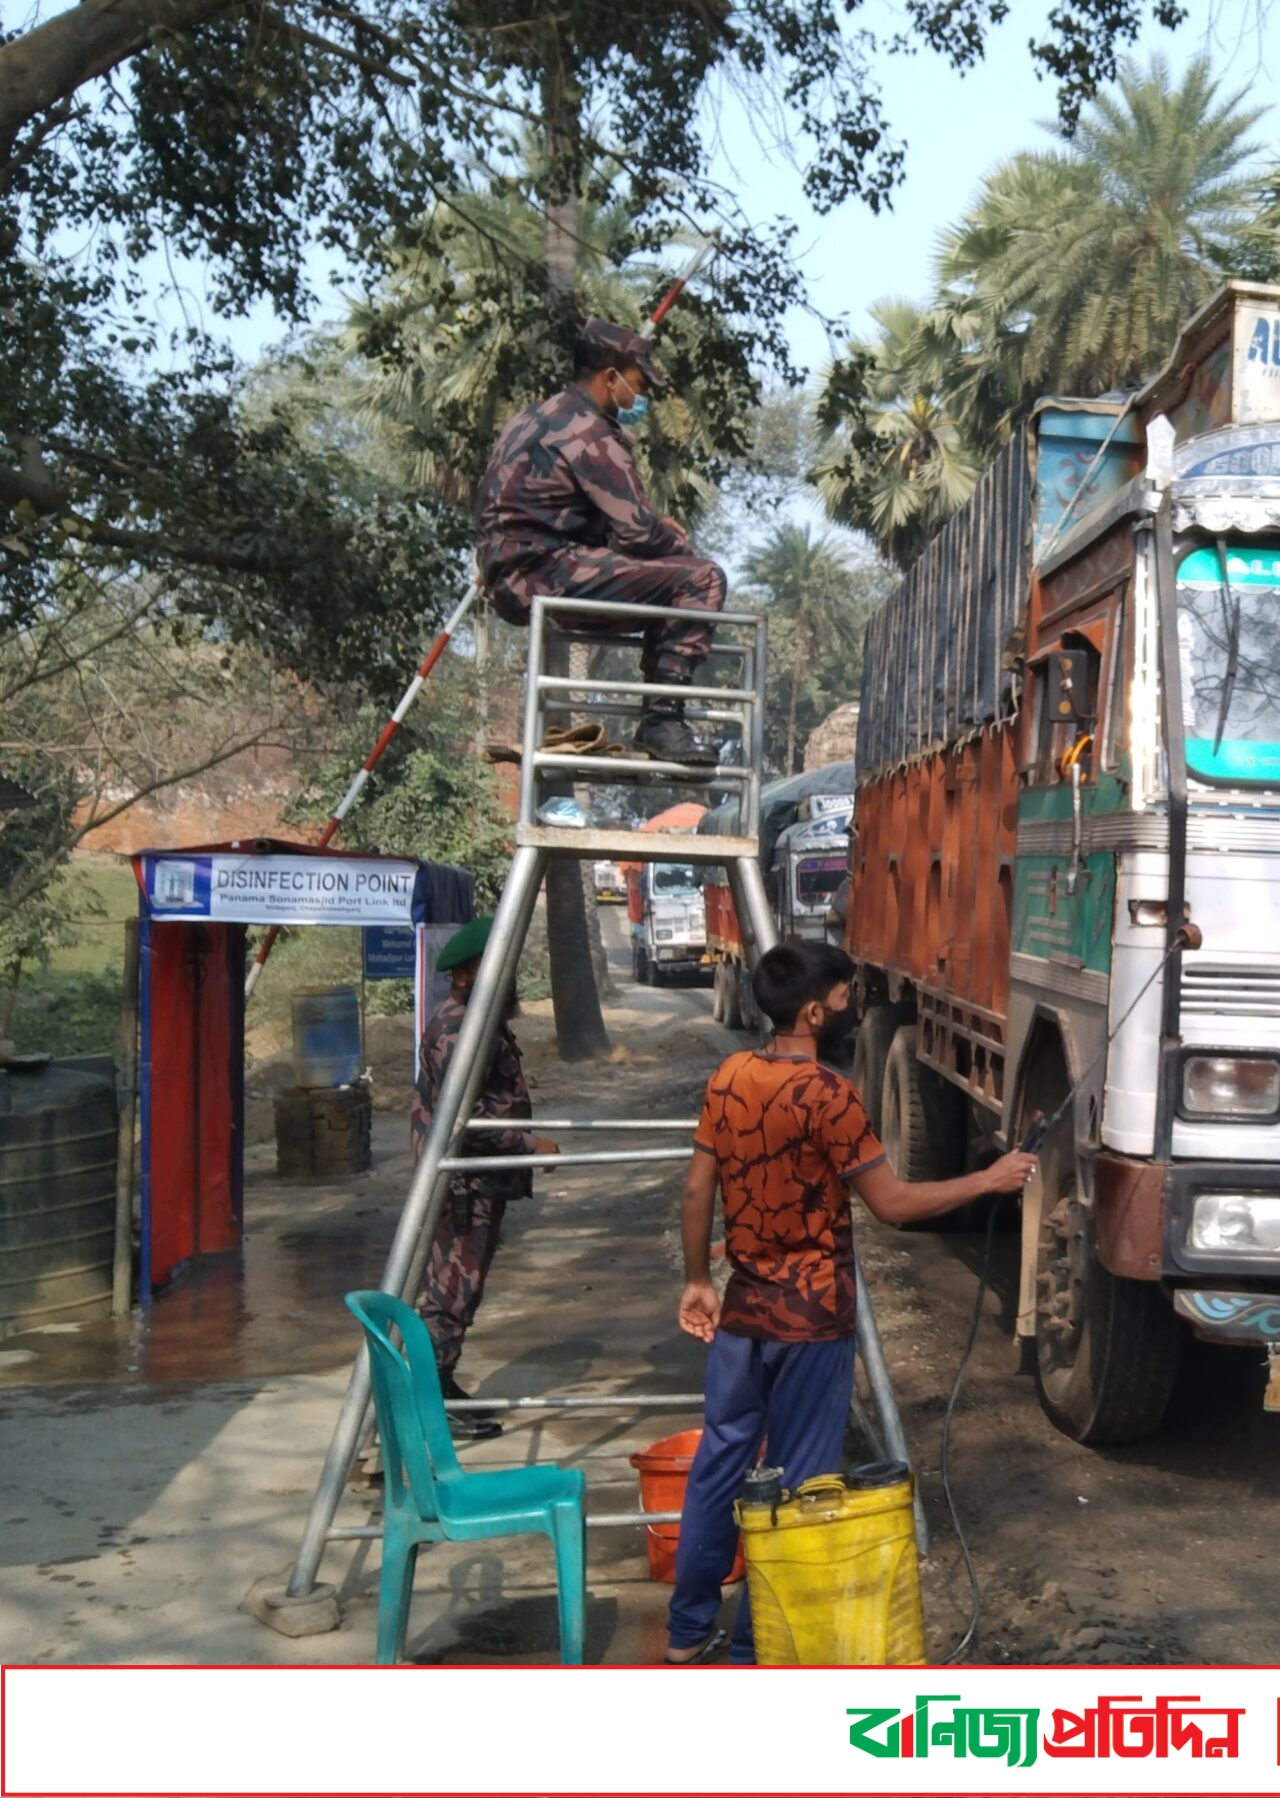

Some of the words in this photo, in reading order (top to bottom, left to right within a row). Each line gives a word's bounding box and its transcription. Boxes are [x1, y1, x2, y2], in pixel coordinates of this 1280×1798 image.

[217, 870, 348, 891] DISINFECTION
[356, 874, 411, 893] POINT
[220, 893, 265, 903] Panama
[269, 895, 335, 906] Sonamasjid
[339, 896, 361, 906] Port
[365, 898, 388, 906] Link
